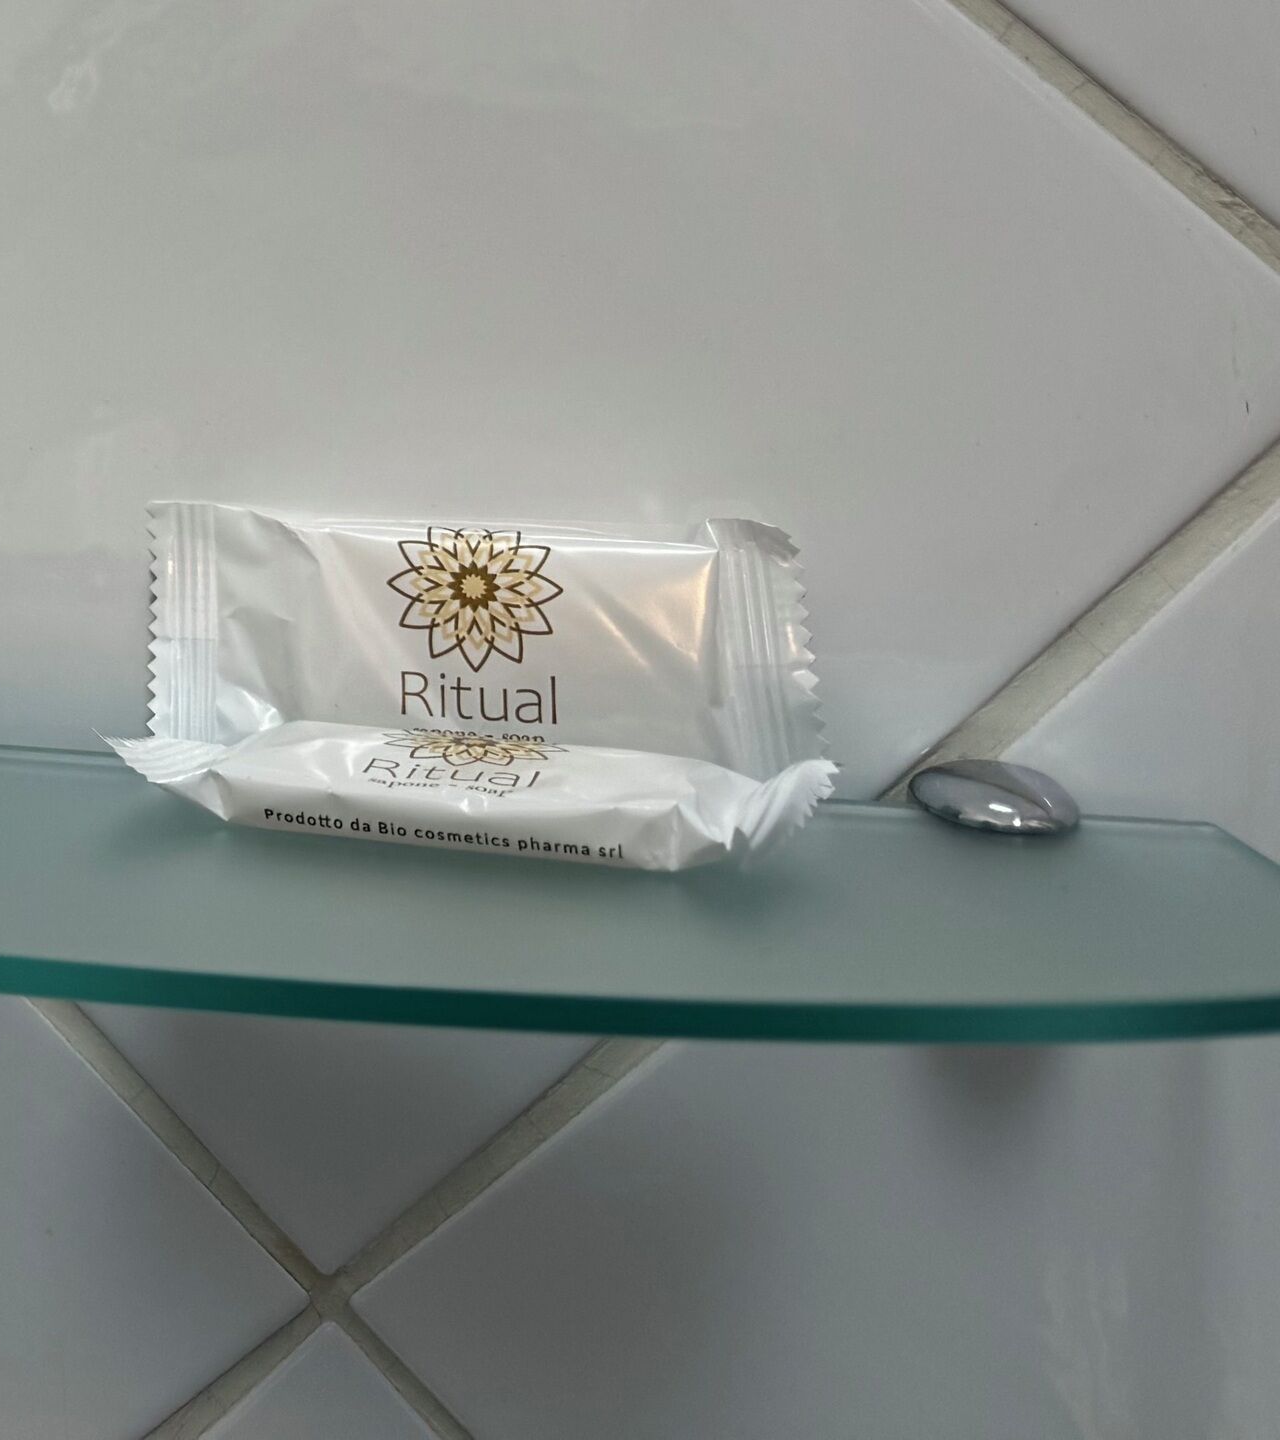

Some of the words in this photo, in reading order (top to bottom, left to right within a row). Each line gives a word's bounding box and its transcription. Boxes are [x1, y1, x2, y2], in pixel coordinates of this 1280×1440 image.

[401, 671, 557, 725] Ritual
[362, 758, 540, 788] Ritual
[368, 777, 439, 788] sapone
[264, 809, 343, 829] Prodotto
[350, 818, 371, 832] da
[378, 821, 407, 836] Bio
[414, 828, 510, 847] cosmetics
[518, 837, 590, 856] pharma
[599, 844, 624, 859] srl
